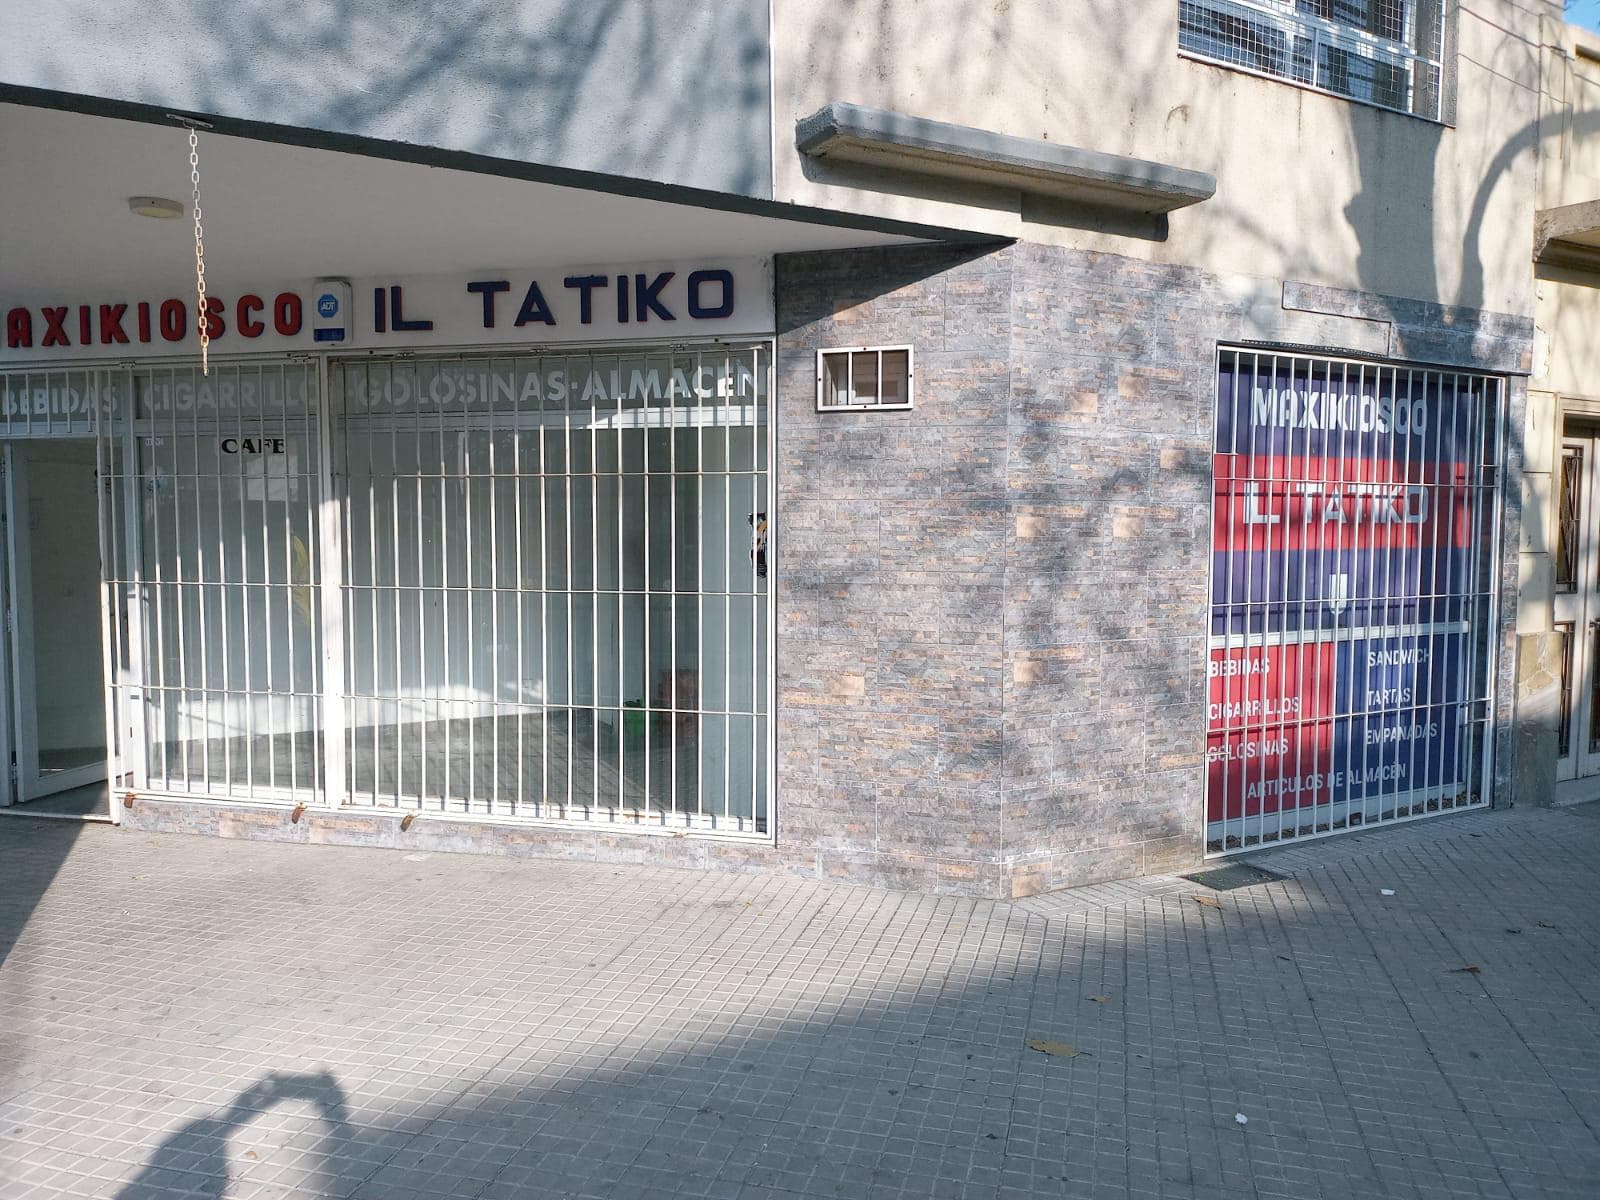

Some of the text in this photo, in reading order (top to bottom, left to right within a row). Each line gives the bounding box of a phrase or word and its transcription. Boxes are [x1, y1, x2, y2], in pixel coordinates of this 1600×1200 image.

[321, 301, 336, 311] ADT
[374, 270, 735, 333] IL TATIKO
[2, 386, 118, 416] BEBIDAS
[358, 369, 563, 408] GOLOSINAS
[581, 364, 766, 401] ALMACEN
[1251, 386, 1428, 437] MAXIKIOSCO
[221, 438, 285, 455] CAFE
[1243, 482, 1429, 524] IL TATIKO
[1210, 657, 1271, 678] BEBIDAS
[1368, 647, 1431, 667] SANDWICH
[1209, 696, 1300, 720] CIGARRILLOS
[1367, 687, 1412, 706] TARTAS
[1366, 722, 1438, 745] EMPANADAS
[1208, 738, 1289, 763] GOLOSINAS
[1327, 771, 1344, 789] DE
